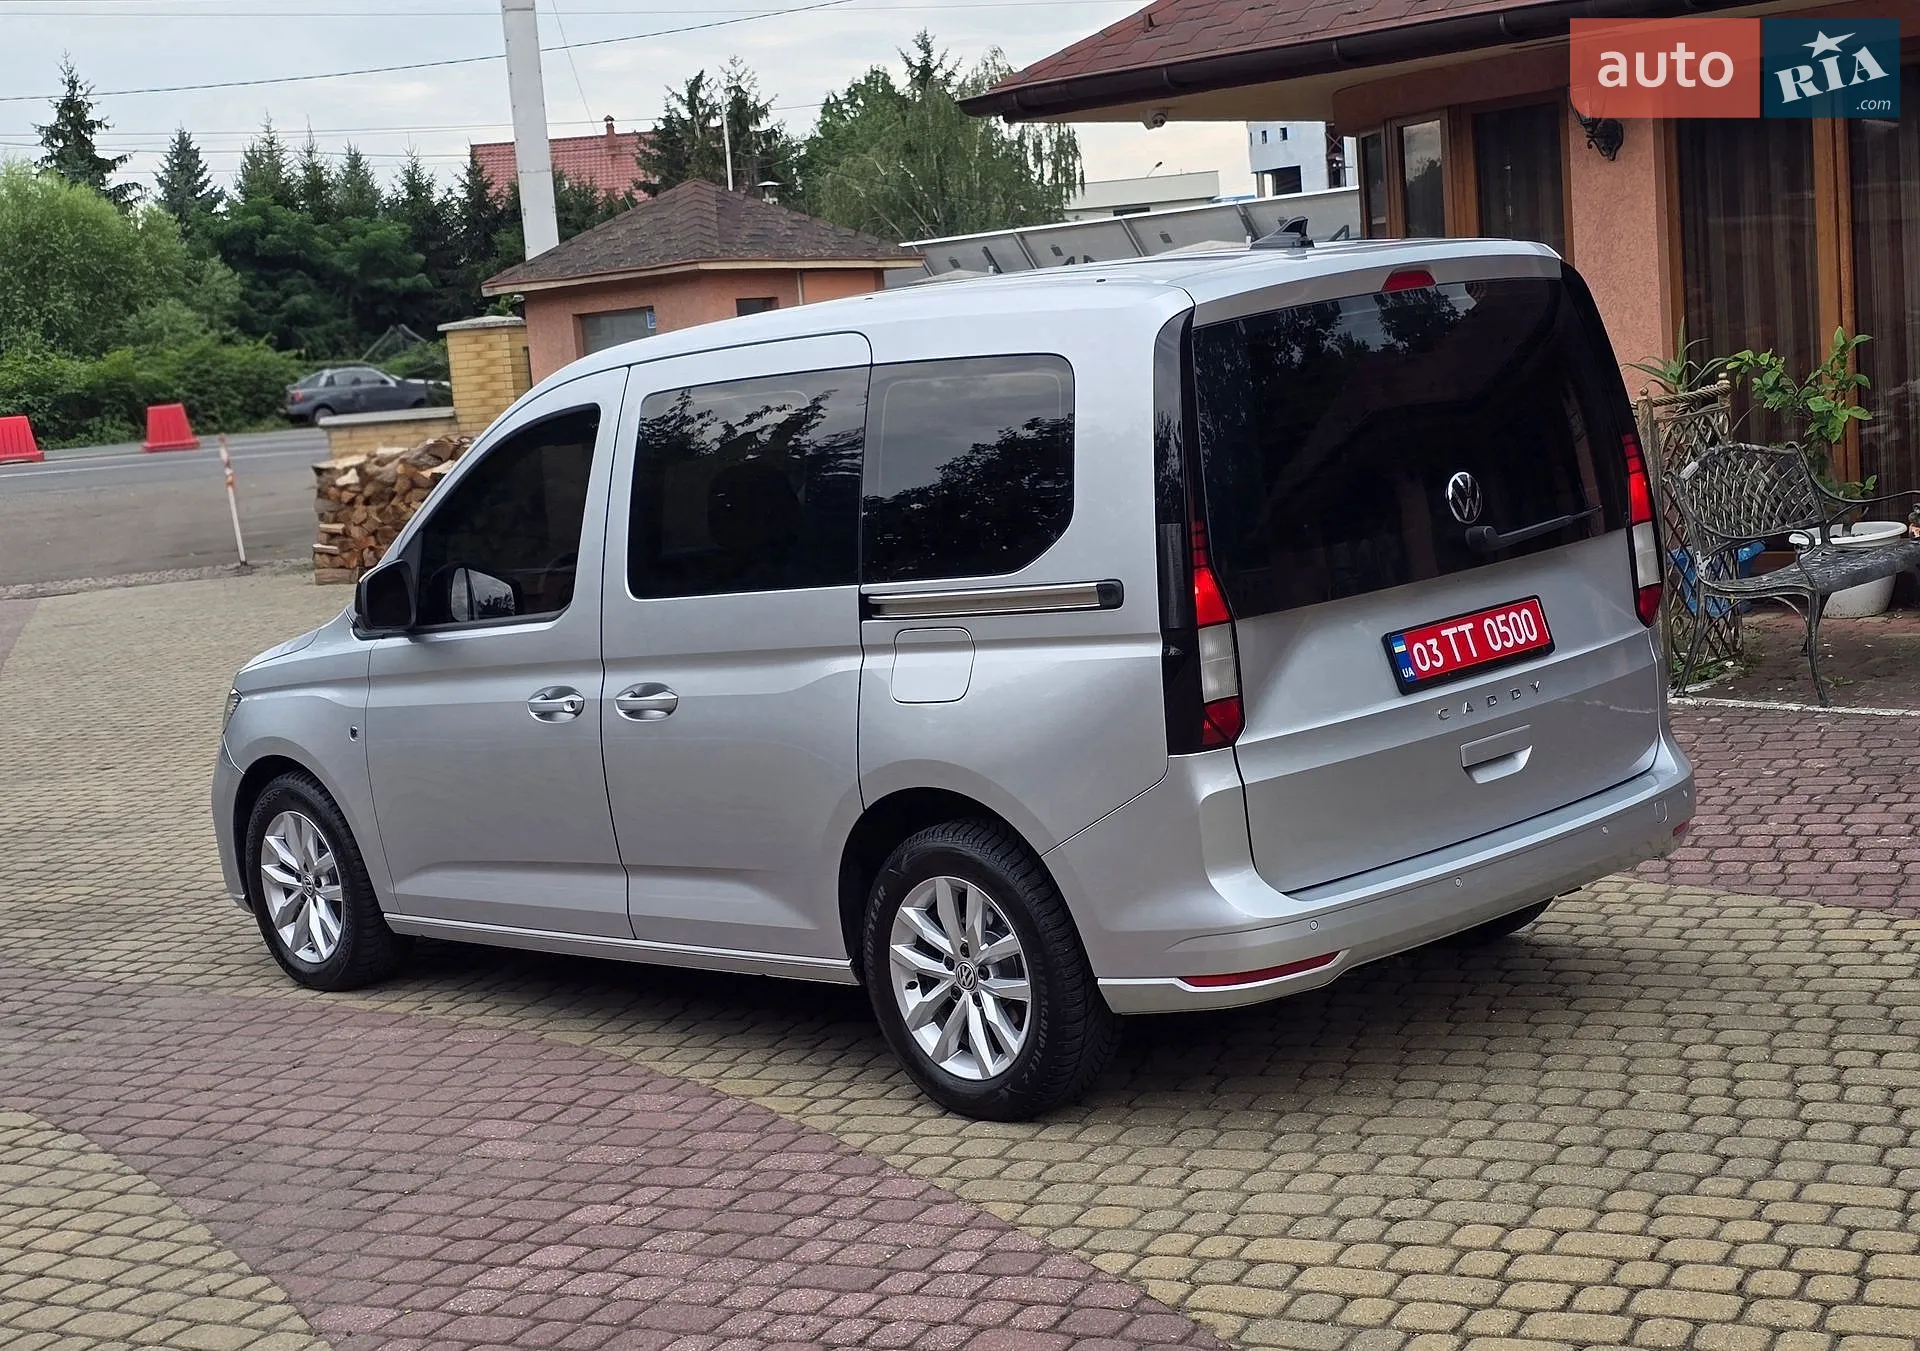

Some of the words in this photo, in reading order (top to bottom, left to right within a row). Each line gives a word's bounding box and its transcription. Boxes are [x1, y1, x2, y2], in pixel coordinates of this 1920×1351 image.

[1412, 638, 1444, 672] 03
[1440, 622, 1478, 663] TT
[1483, 608, 1538, 651] 0500
[1402, 666, 1415, 678] UA
[1437, 680, 1540, 720] CADDY
